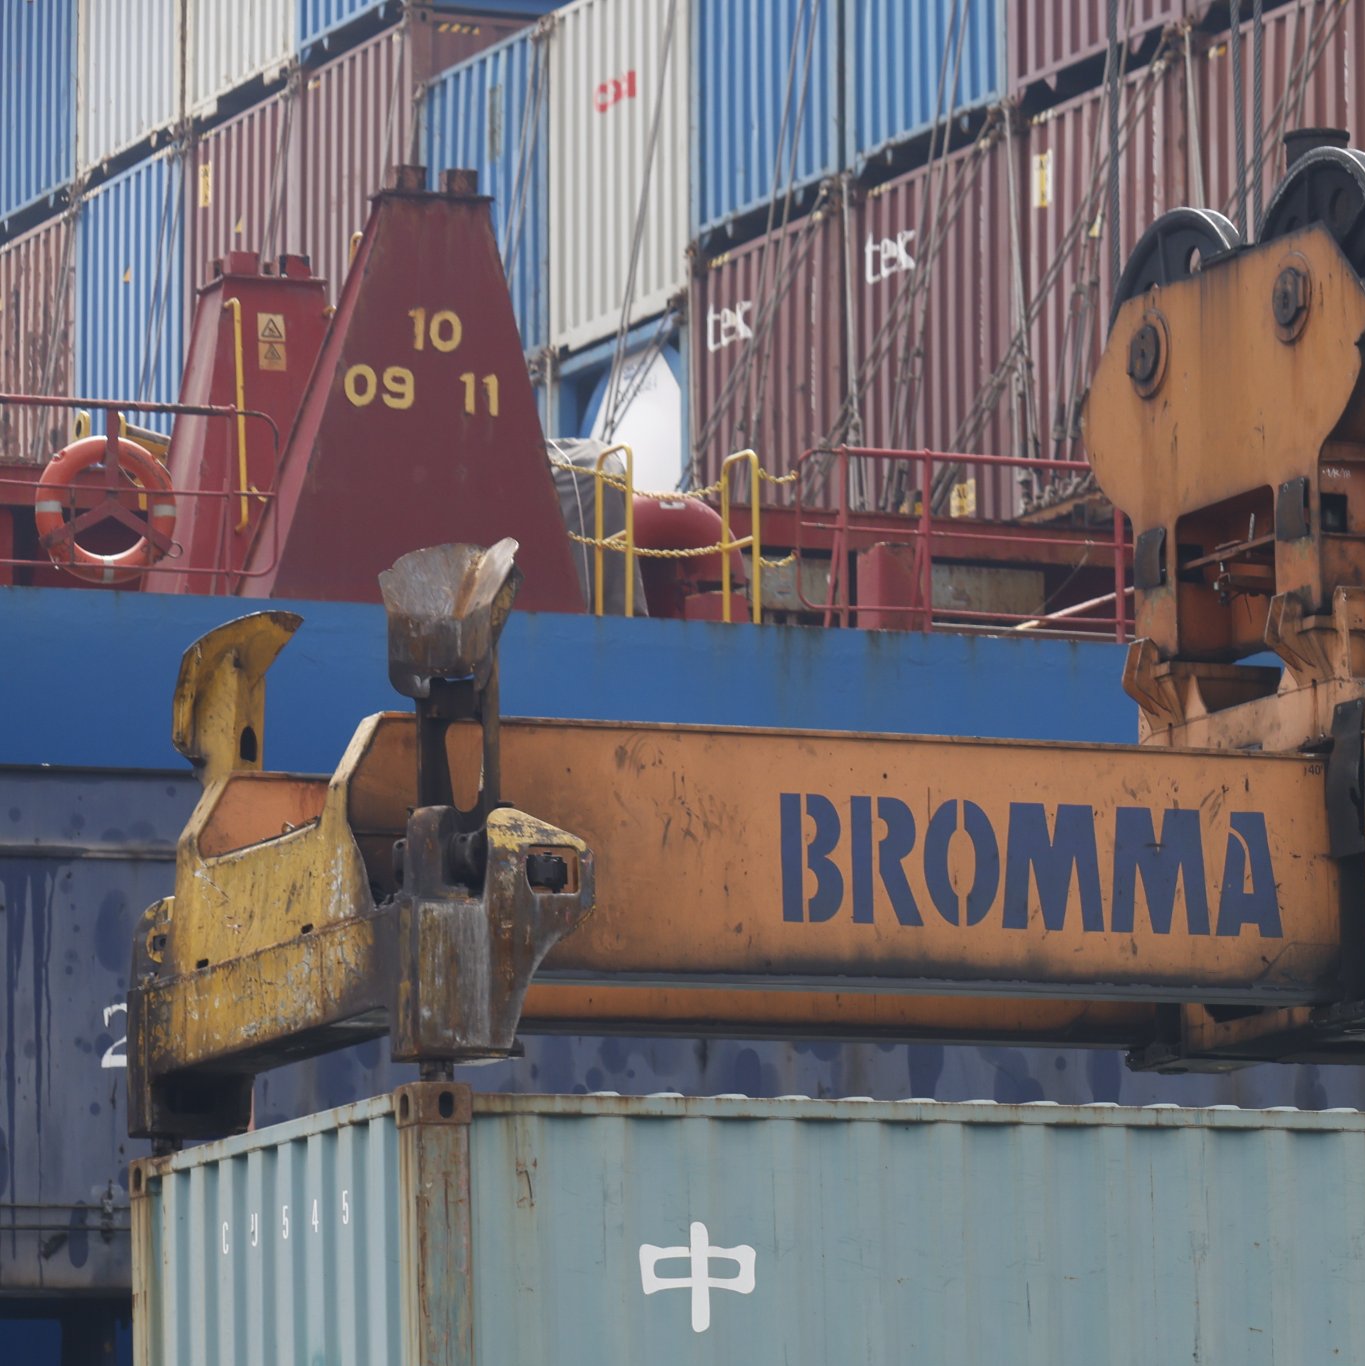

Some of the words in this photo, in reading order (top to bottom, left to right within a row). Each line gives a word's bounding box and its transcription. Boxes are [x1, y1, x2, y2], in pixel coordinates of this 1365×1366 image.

[408, 306, 463, 353] 10
[343, 363, 416, 411] 09
[458, 372, 499, 418] 11
[779, 792, 1285, 939] BROMMA
